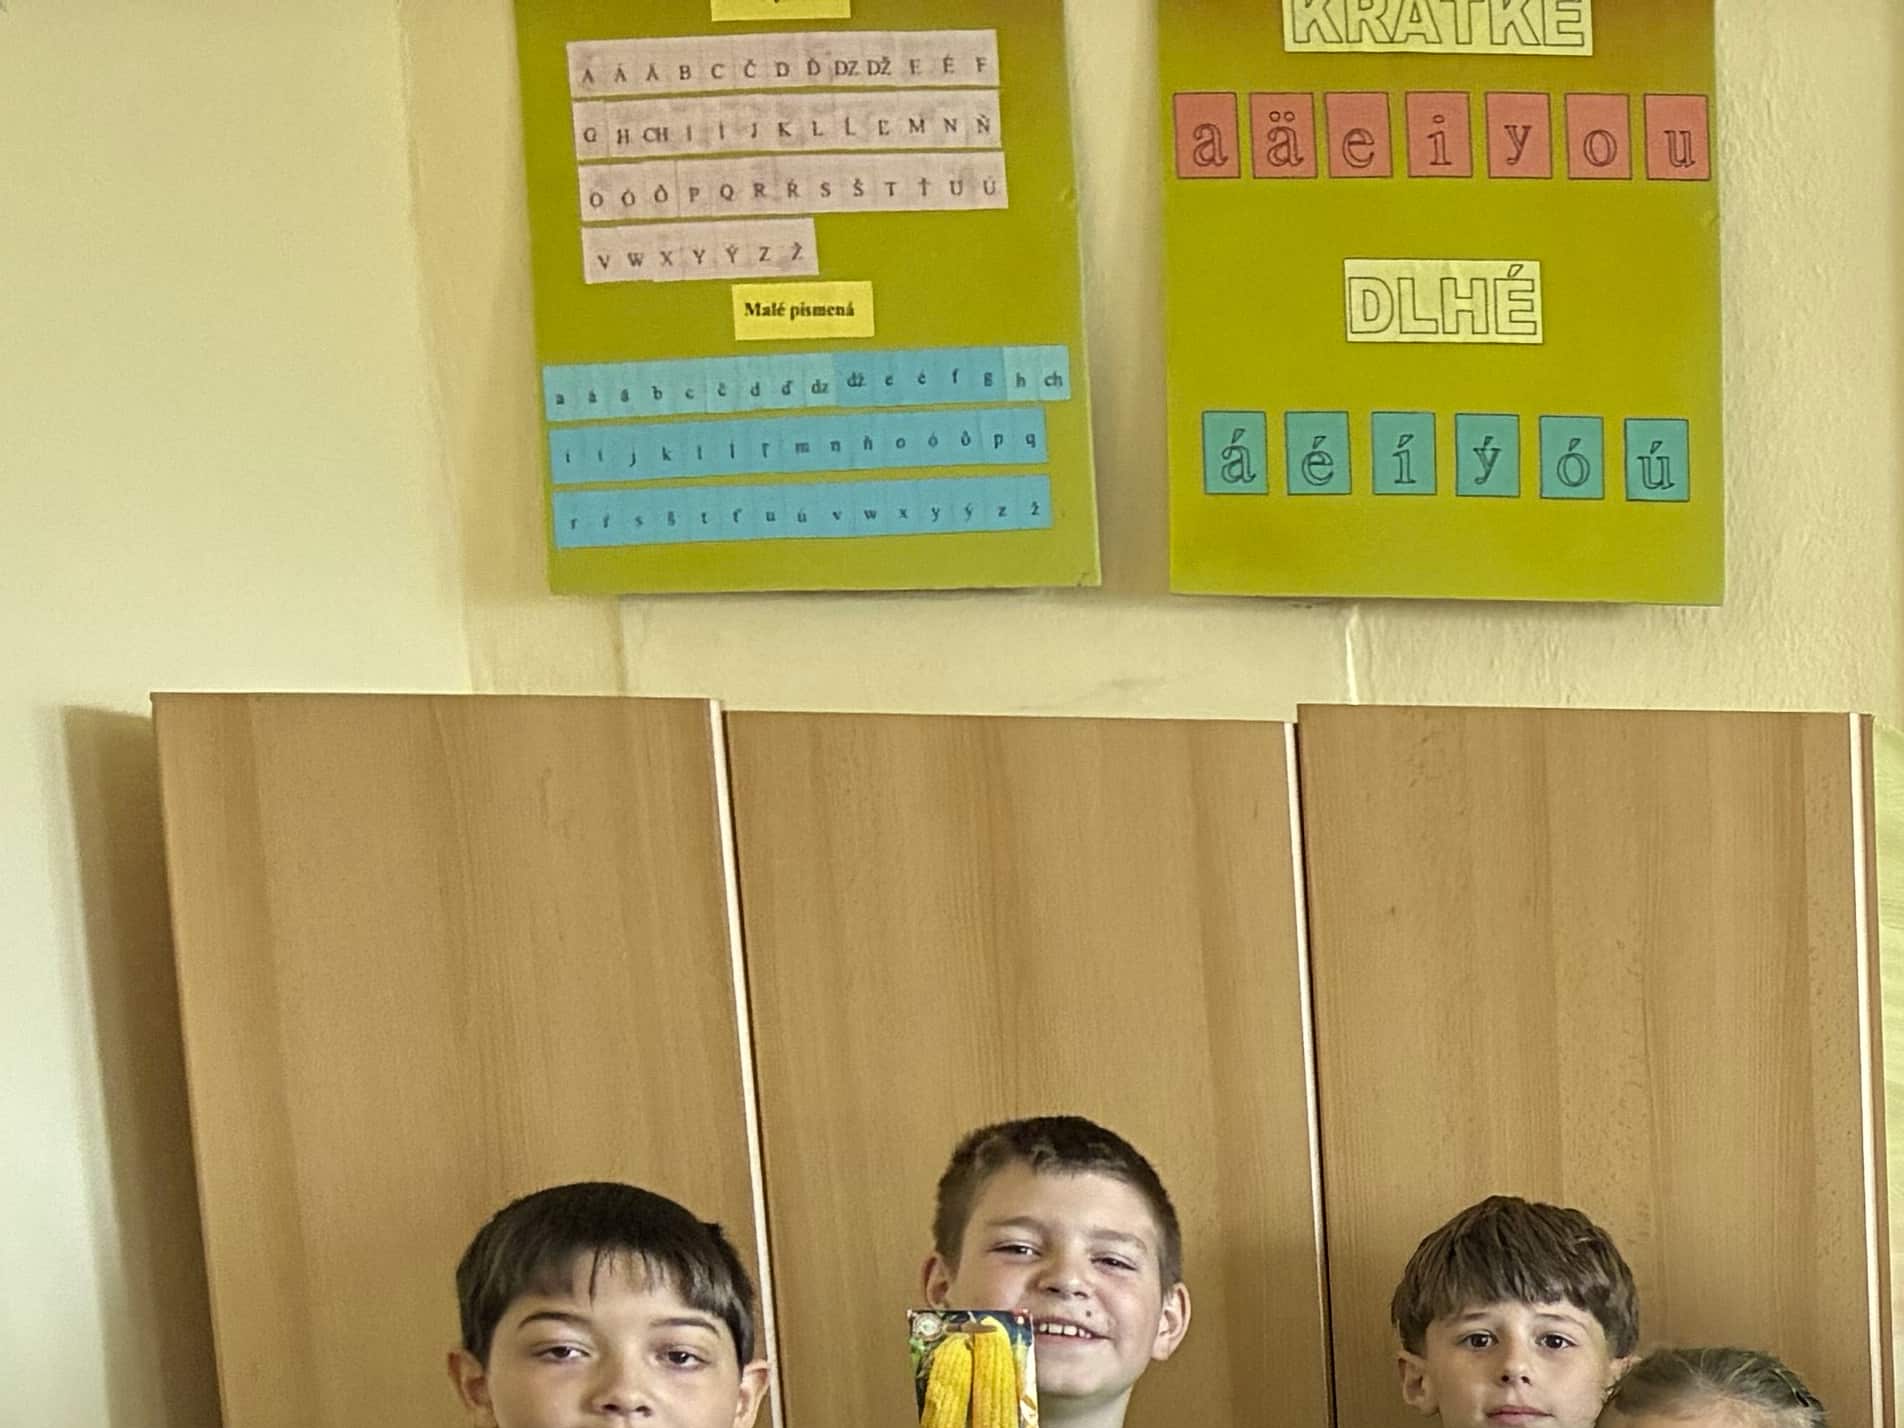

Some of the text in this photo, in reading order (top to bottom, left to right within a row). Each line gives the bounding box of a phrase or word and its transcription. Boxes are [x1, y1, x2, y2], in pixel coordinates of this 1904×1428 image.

[1192, 110, 1696, 169] a ä e i y o u
[744, 301, 785, 318] Malé
[1347, 264, 1535, 335] DLHÉ
[1221, 428, 1675, 489] á é í ý ó ú
